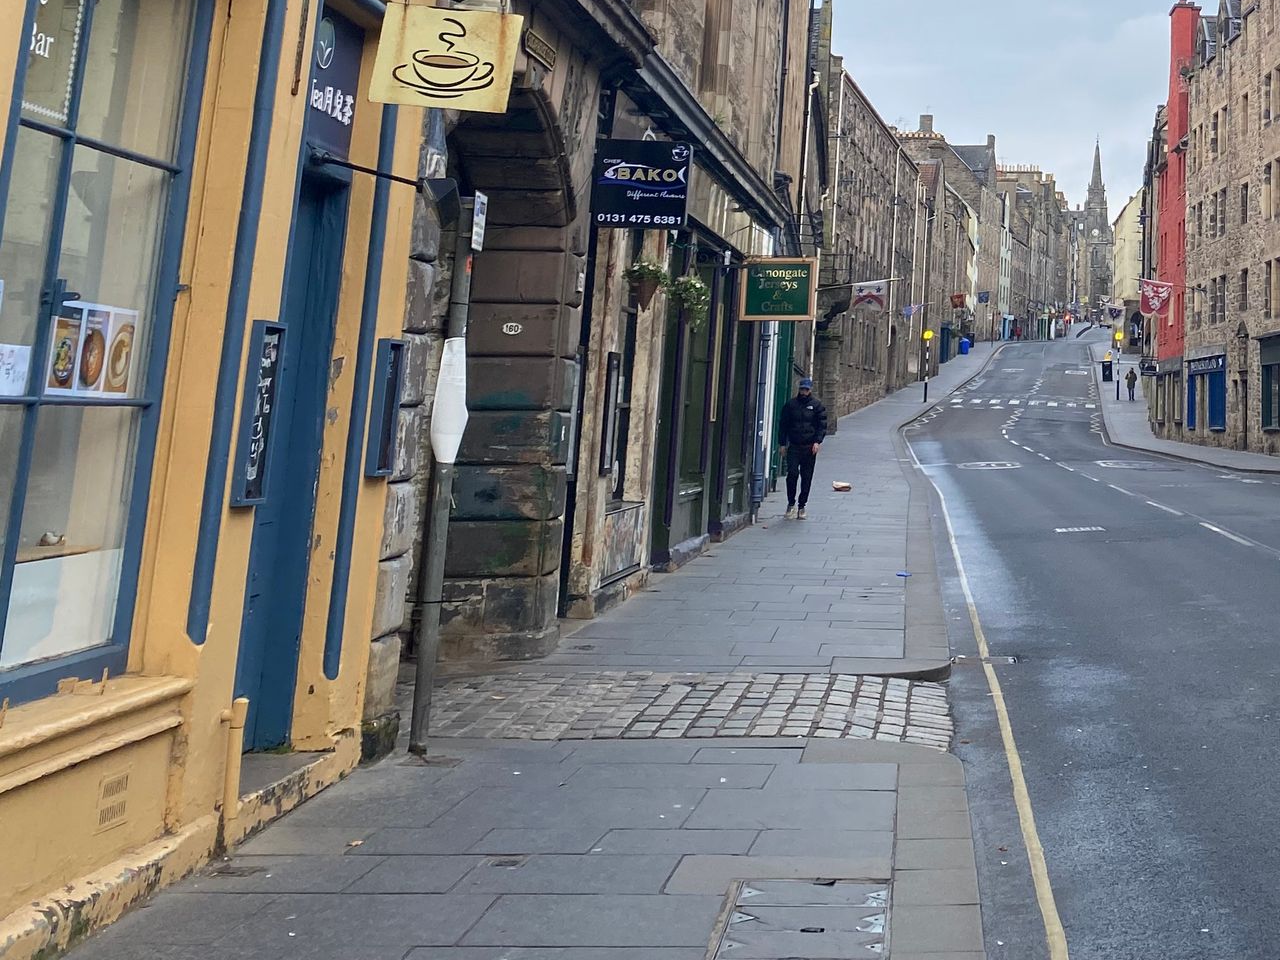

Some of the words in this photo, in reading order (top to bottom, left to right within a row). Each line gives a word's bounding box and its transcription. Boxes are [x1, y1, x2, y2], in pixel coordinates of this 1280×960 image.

[617, 168, 678, 182] BAKO
[597, 213, 626, 222] 0131
[629, 215, 651, 224] 475
[653, 215, 682, 225] 6381
[758, 278, 798, 292] Jerseys
[761, 301, 793, 312] Crafts
[505, 324, 520, 333] 160
